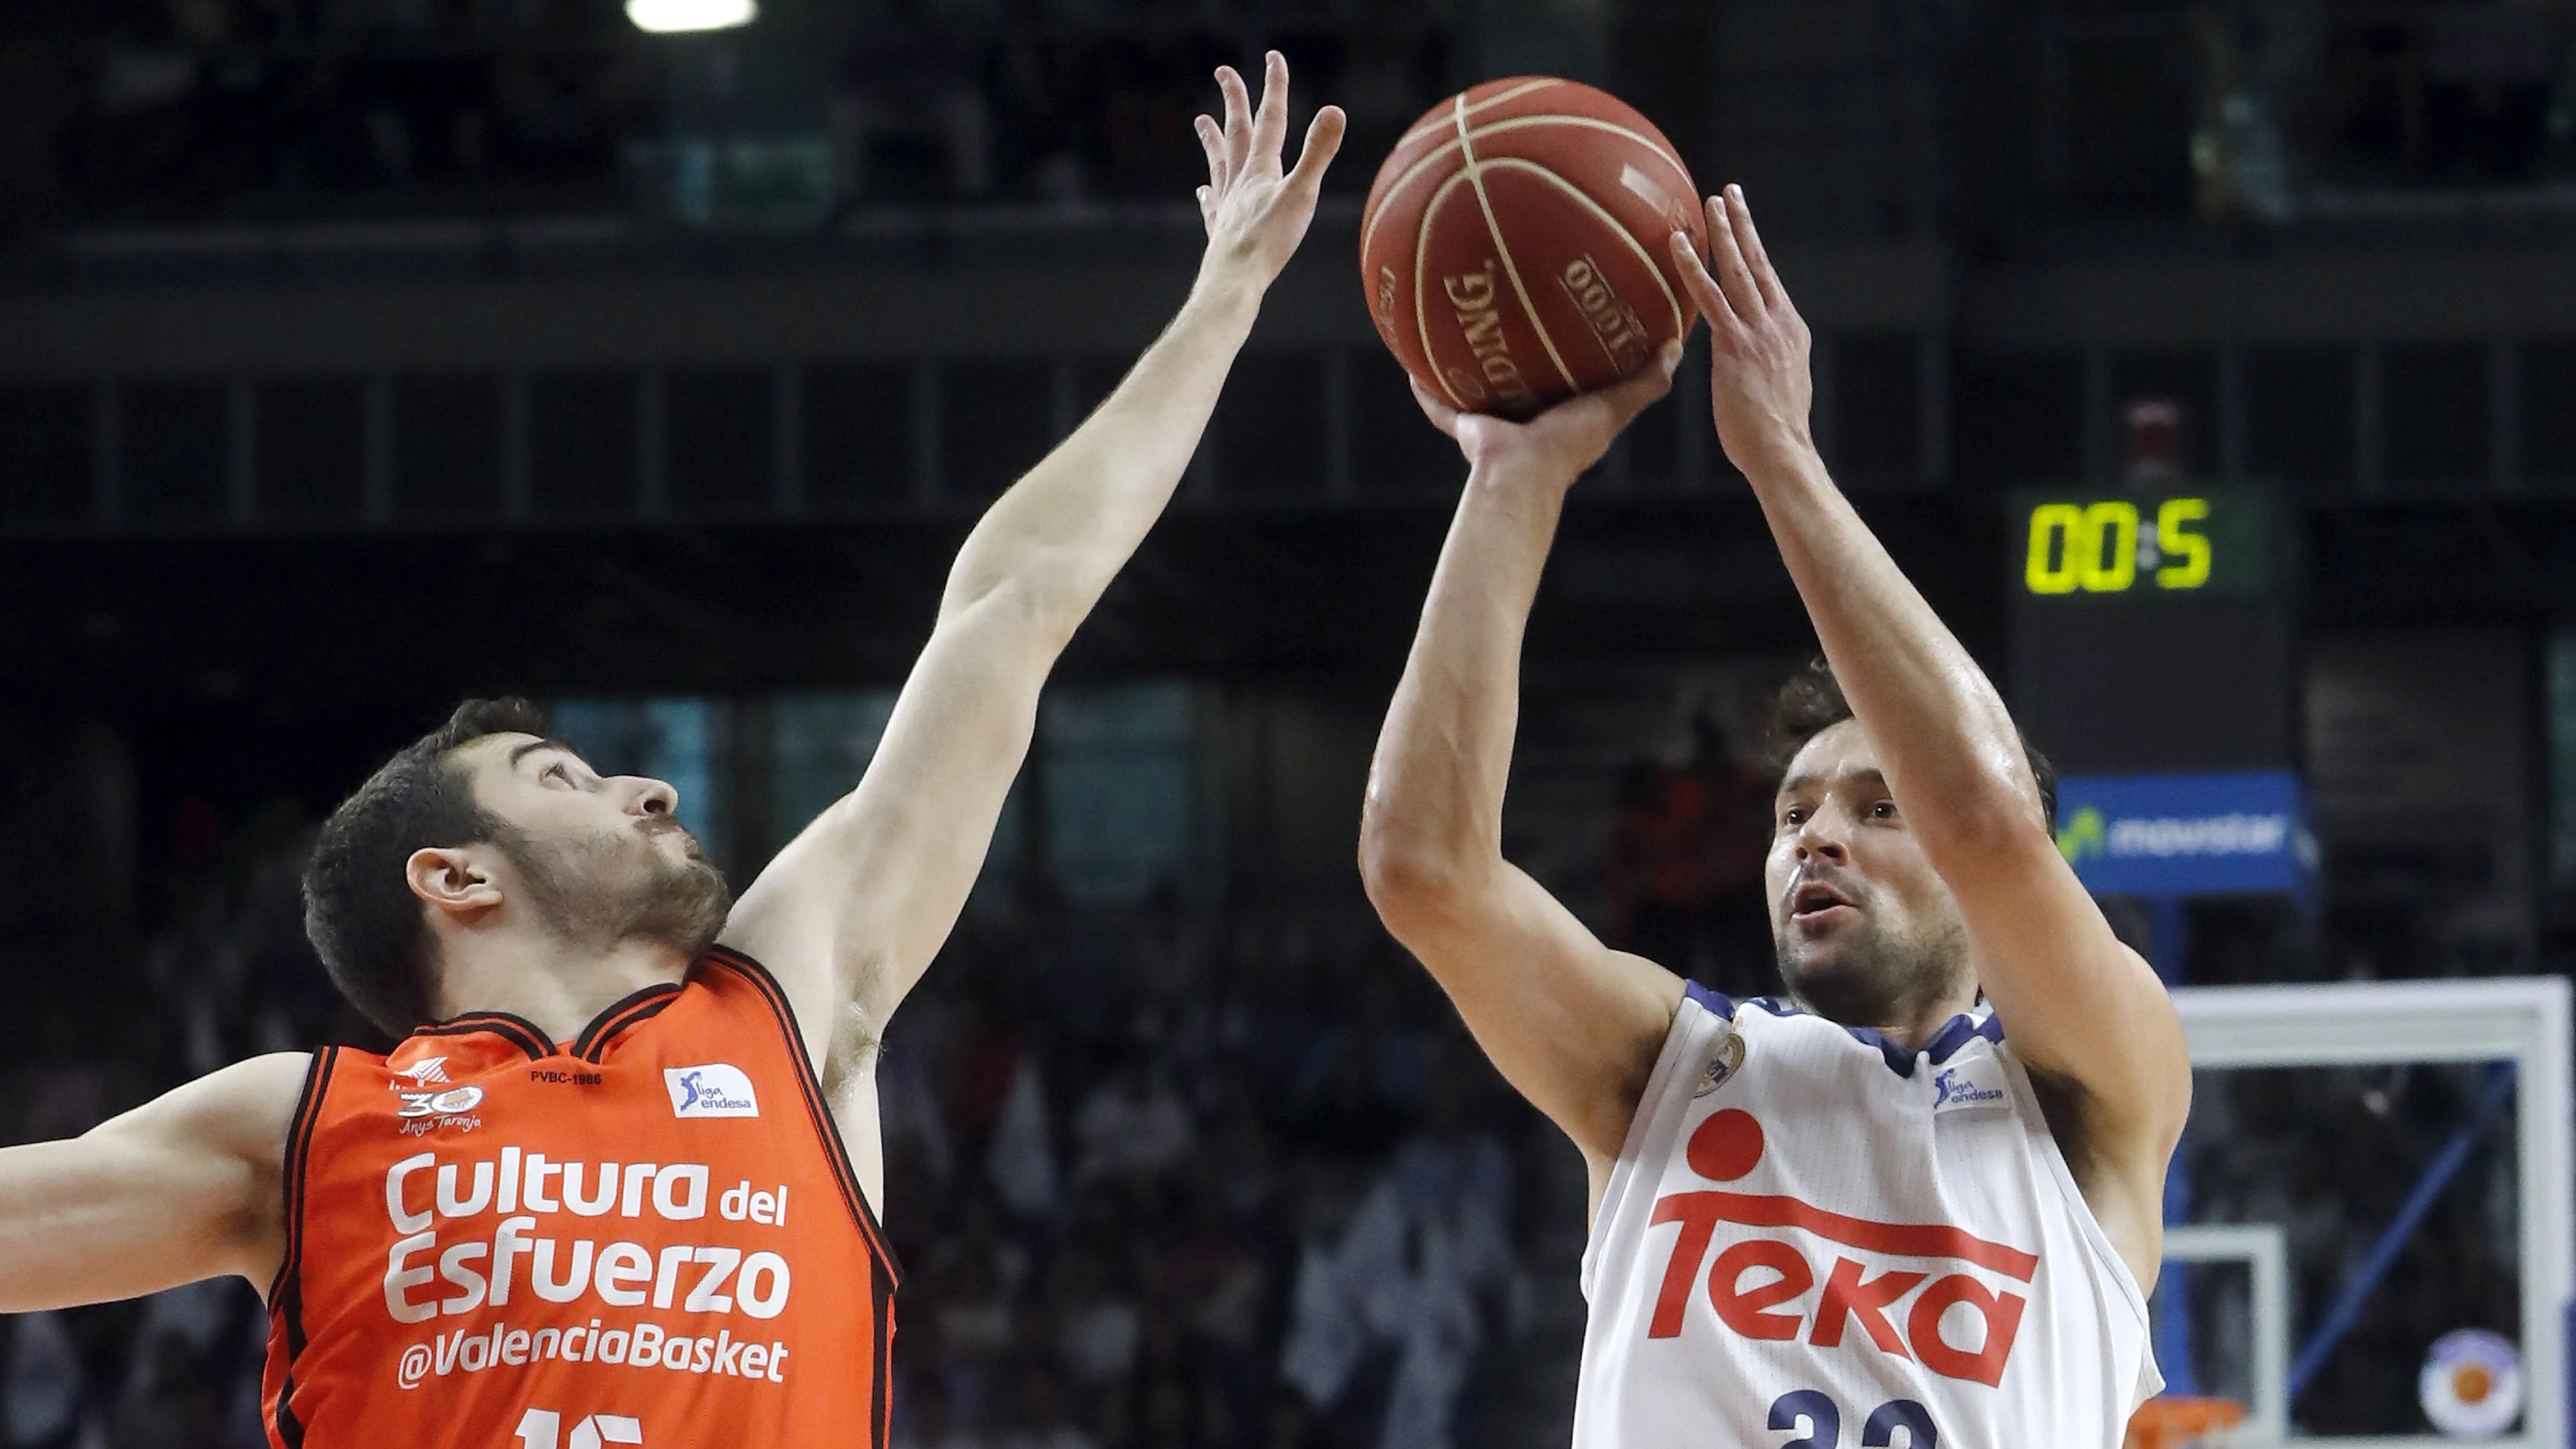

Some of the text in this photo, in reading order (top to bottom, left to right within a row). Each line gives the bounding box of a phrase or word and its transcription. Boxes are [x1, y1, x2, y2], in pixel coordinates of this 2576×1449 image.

[530, 1071, 602, 1085] PVBC-1986
[696, 1082, 723, 1099] liga
[1951, 1089, 2003, 1103] endesa
[701, 1097, 751, 1109] endesa
[399, 1114, 482, 1137] Anys Taronja
[386, 1147, 788, 1234] Cultura del
[384, 1216, 790, 1324] Esfuerzo
[398, 1319, 789, 1390] @ValenciaBasket
